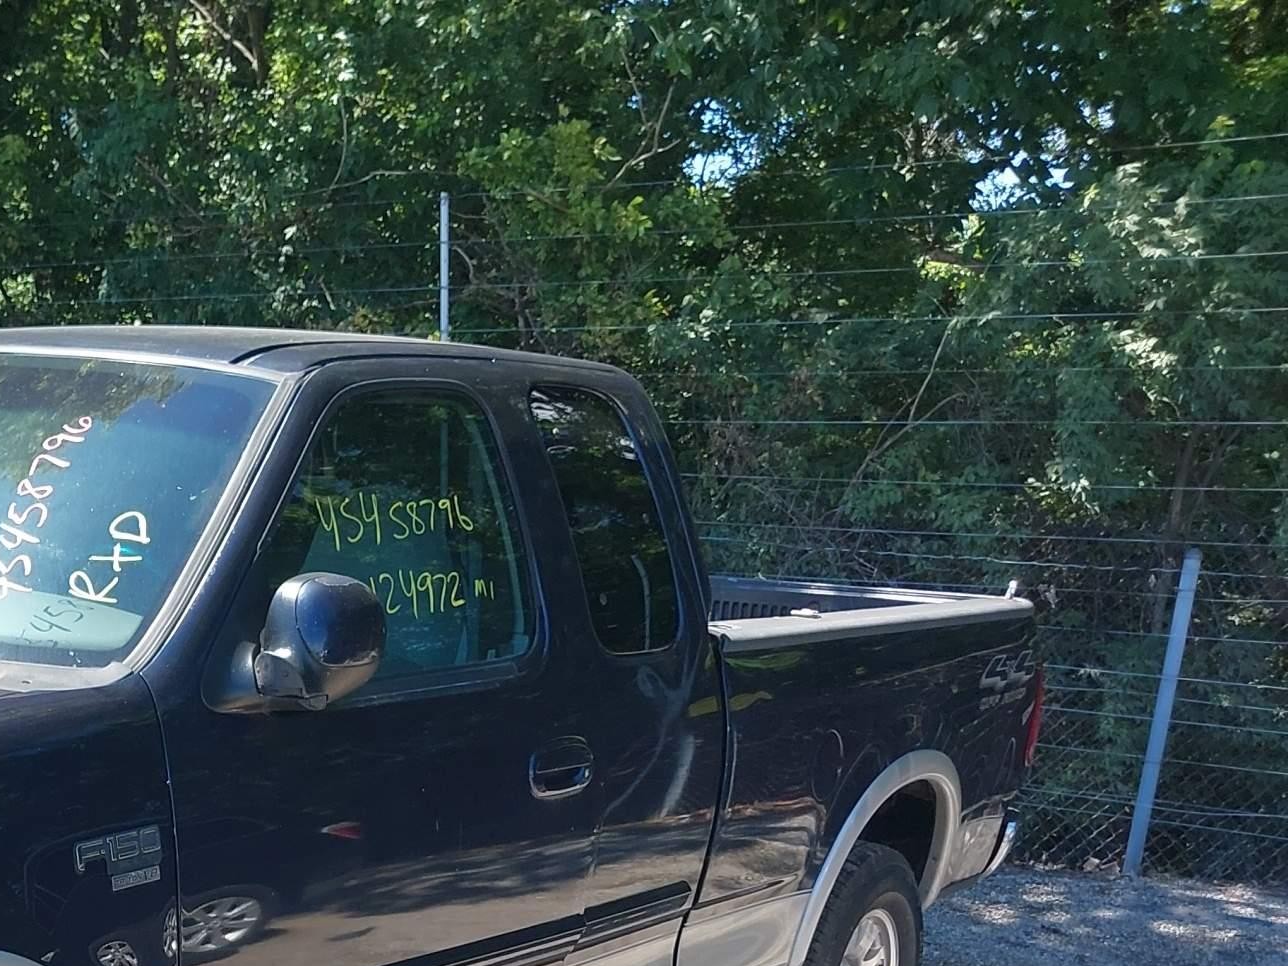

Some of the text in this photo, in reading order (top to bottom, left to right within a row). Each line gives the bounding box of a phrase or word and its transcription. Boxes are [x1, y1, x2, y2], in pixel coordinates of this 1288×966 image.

[315, 491, 475, 551] 45458796
[68, 510, 151, 604] R+D
[369, 568, 467, 619] 124972
[74, 824, 162, 873] F-150
